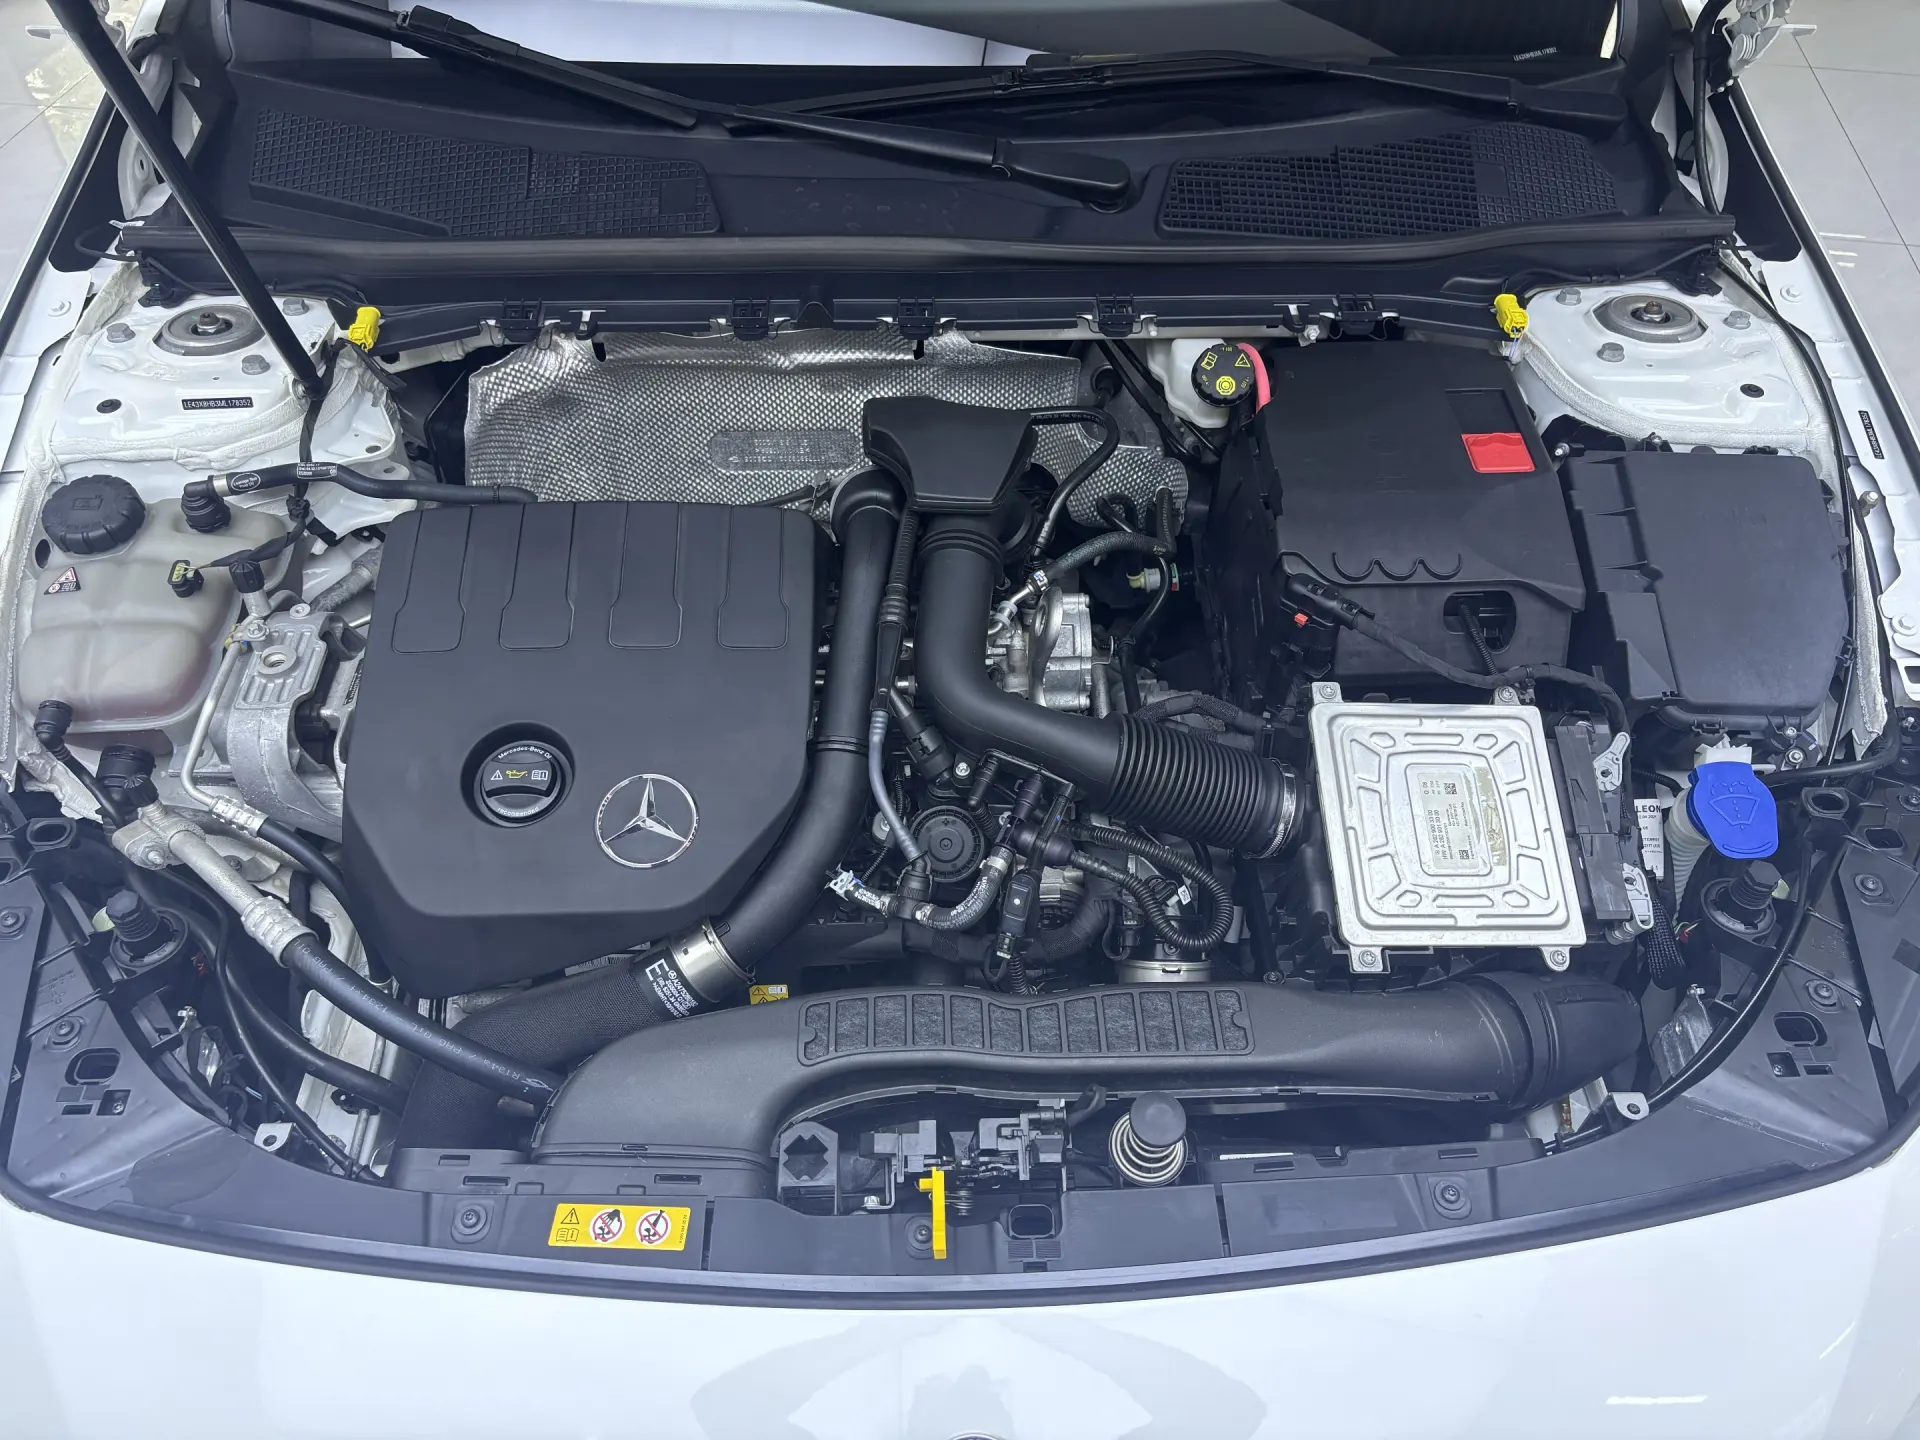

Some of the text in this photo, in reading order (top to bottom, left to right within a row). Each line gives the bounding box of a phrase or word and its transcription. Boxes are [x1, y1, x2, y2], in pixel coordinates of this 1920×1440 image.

[498, 746, 544, 759] Mercedes-Benz
[313, 955, 332, 973] PAG
[645, 958, 669, 981] E
[439, 1038, 462, 1054] PAG
[483, 1058, 520, 1080] R134a
